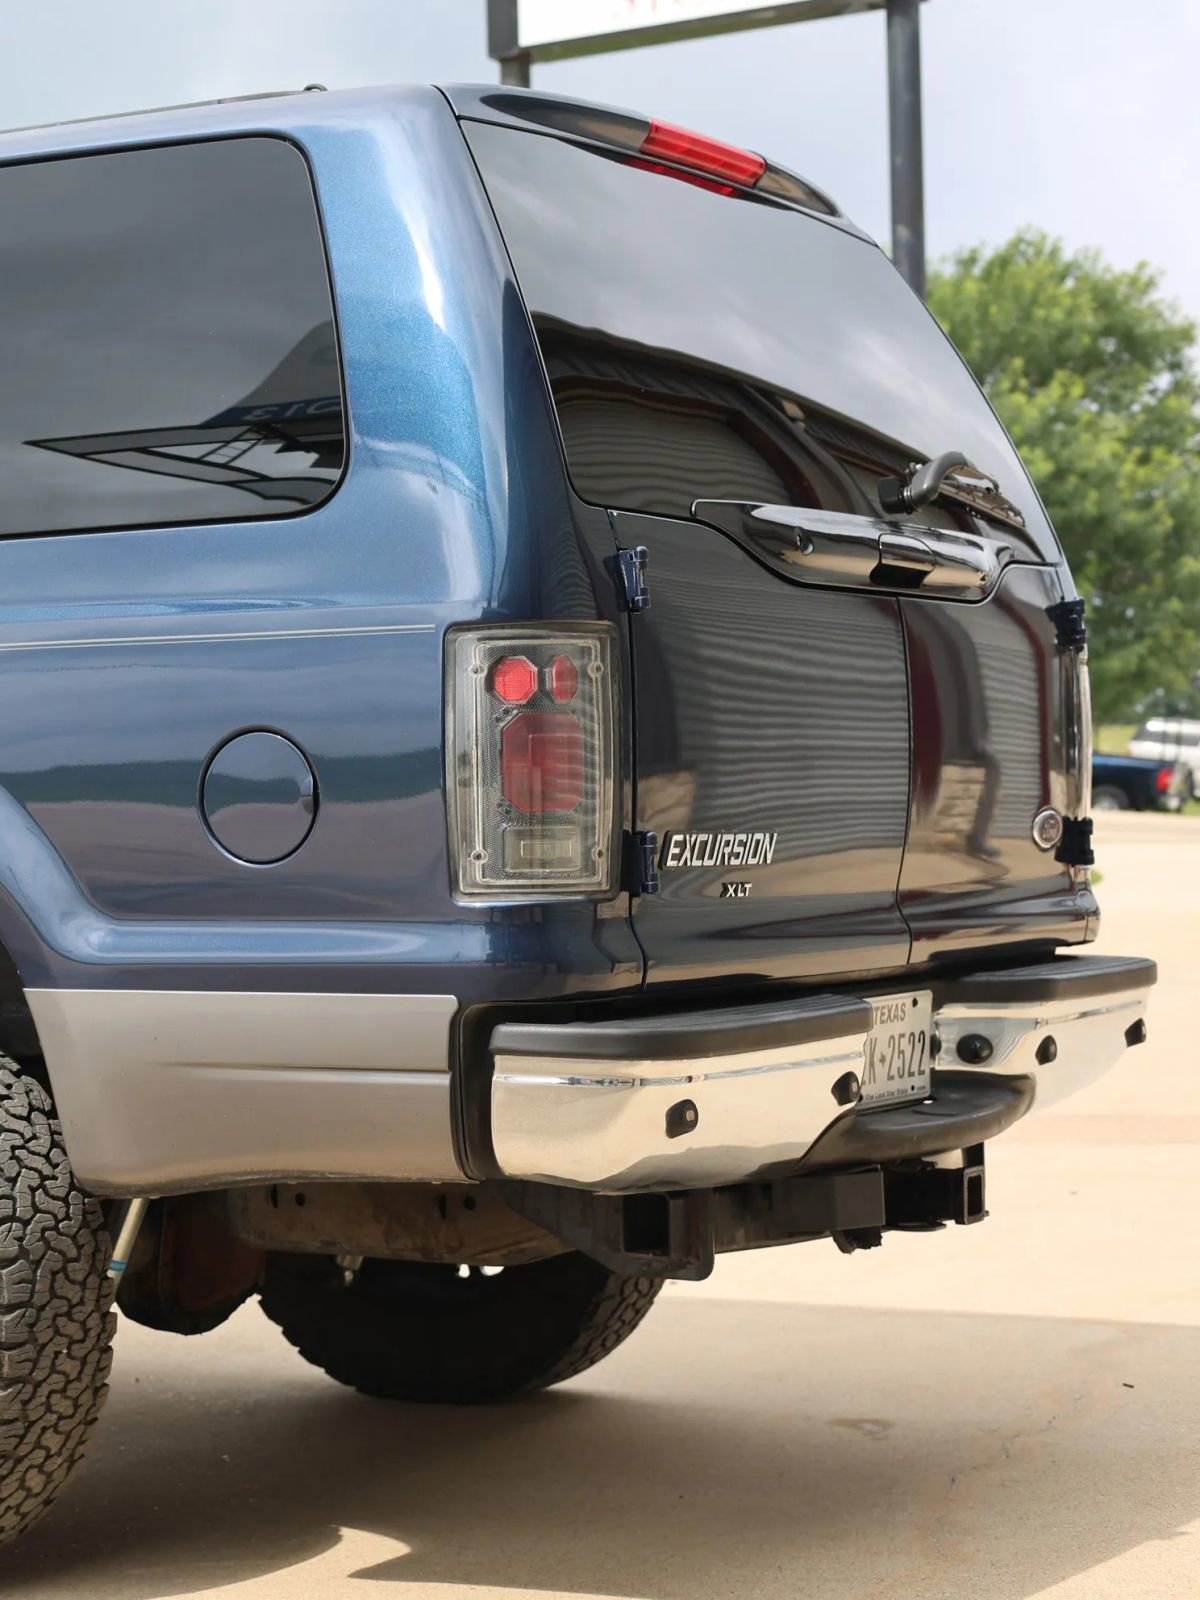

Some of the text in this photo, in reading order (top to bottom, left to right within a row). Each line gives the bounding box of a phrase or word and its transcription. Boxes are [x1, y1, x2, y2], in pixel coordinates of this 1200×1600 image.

[667, 832, 777, 867] EXCURSION
[726, 883, 752, 897] XLT
[874, 1002, 906, 1025] TEXAS
